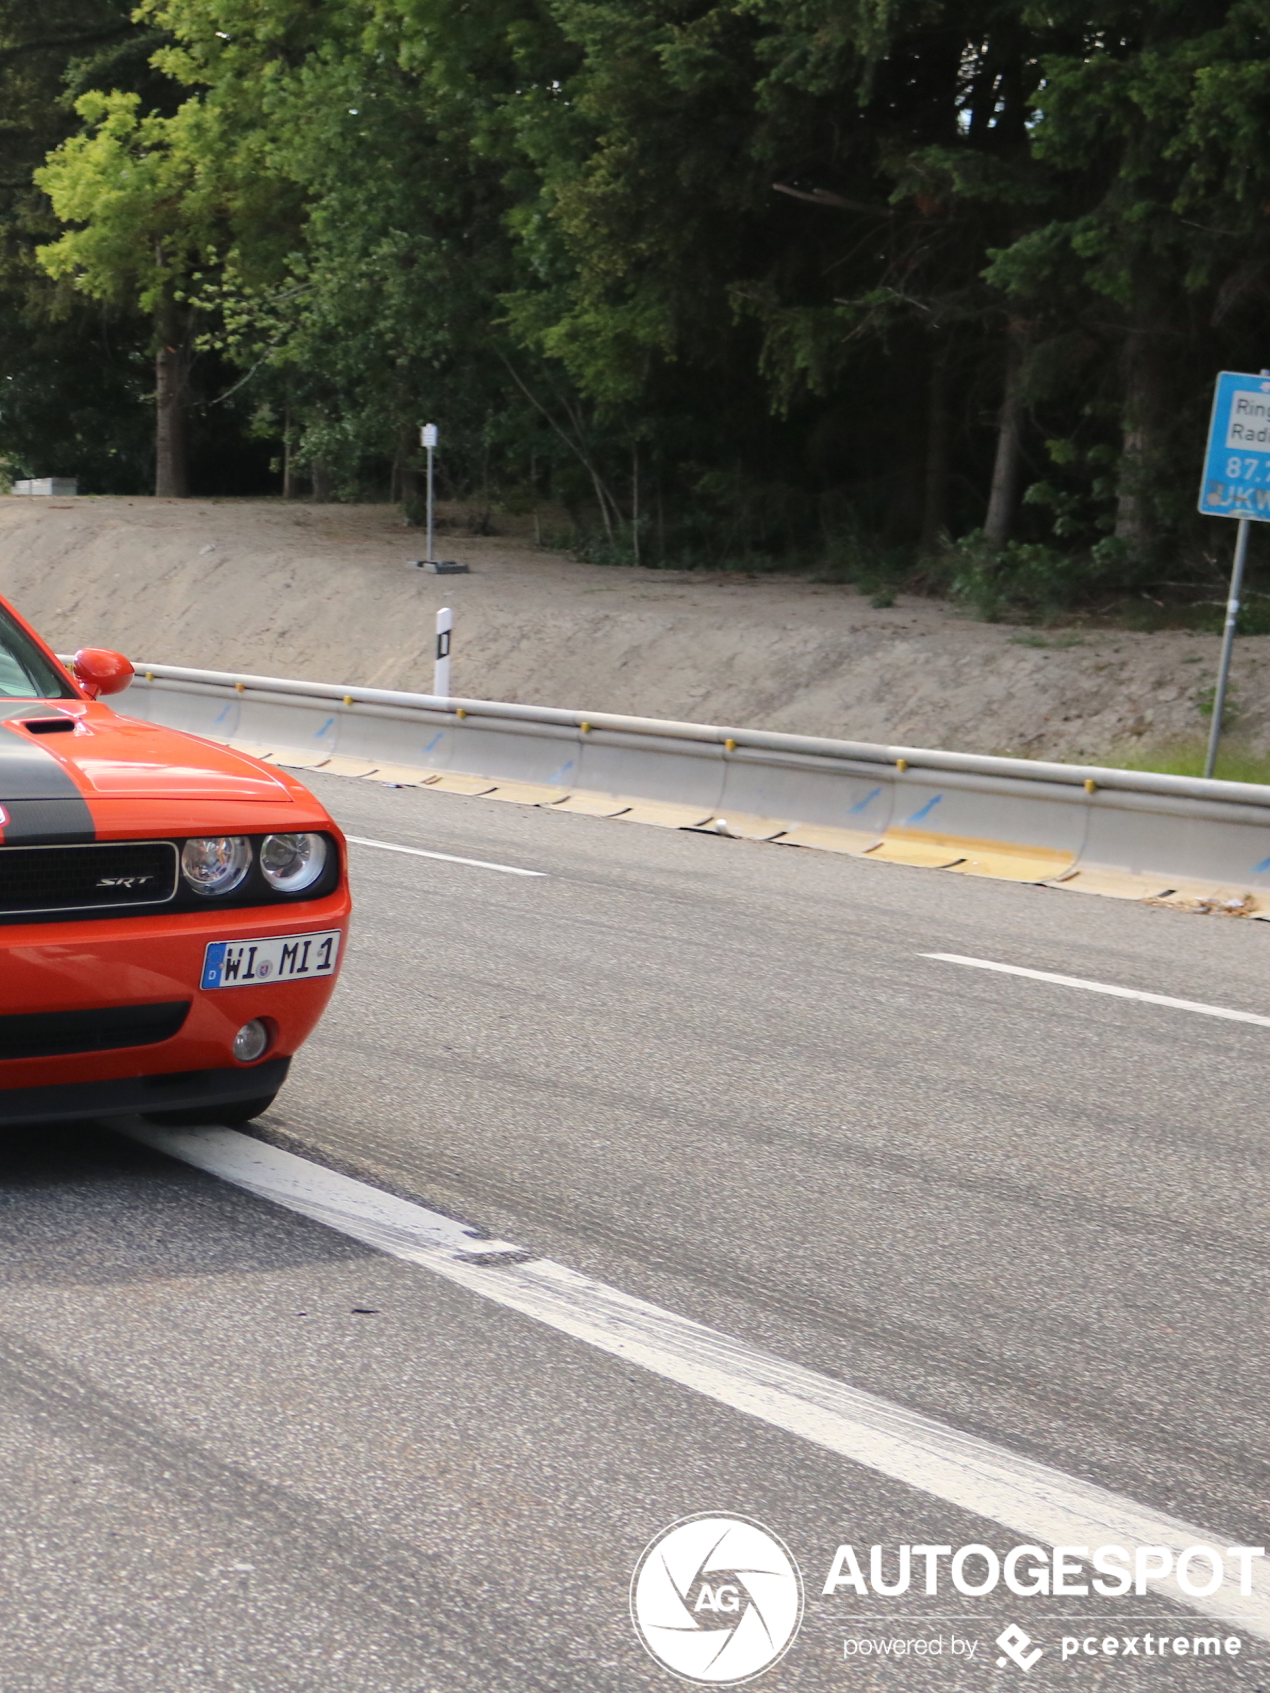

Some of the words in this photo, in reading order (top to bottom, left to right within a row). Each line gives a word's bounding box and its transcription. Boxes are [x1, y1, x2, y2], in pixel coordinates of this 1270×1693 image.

[96, 876, 154, 888] SRT
[225, 946, 258, 981] WI
[278, 940, 312, 975] MI
[316, 937, 334, 970] 1
[208, 970, 216, 980] D
